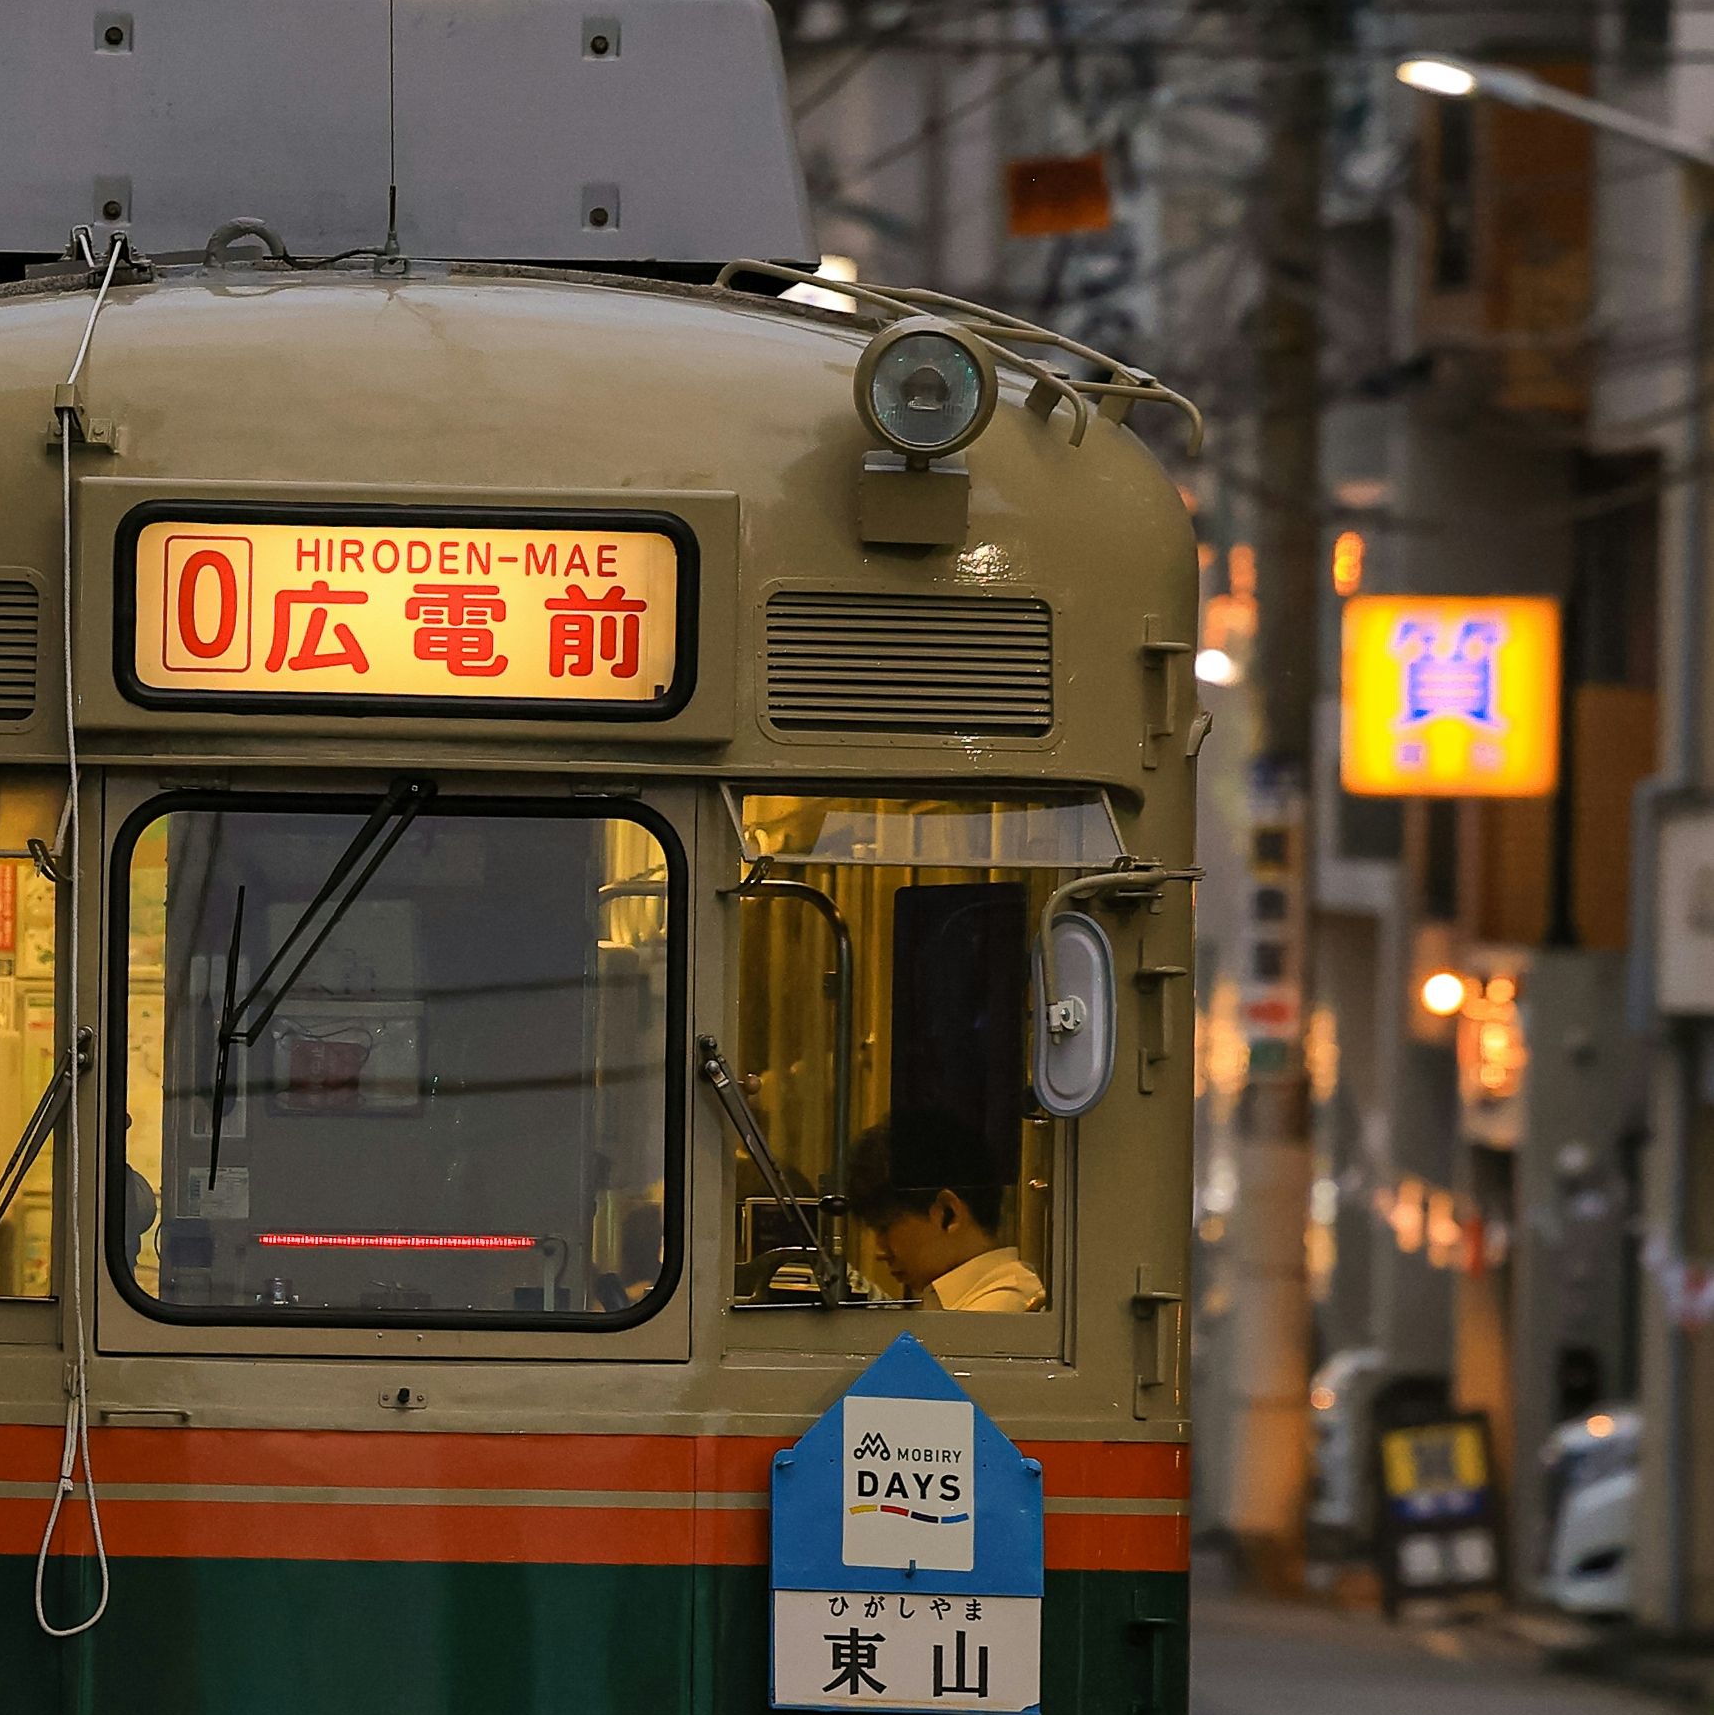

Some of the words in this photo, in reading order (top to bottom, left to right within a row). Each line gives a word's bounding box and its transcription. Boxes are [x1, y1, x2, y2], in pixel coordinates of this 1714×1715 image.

[296, 538, 618, 578] HIRODEN-MAE
[177, 549, 238, 659] 0
[265, 581, 647, 678] 広電前
[897, 1447, 962, 1464] MOBIRY
[857, 1470, 961, 1502] DAYS
[828, 1596, 984, 1622] ひがしやま
[822, 1627, 989, 1698] 東山
